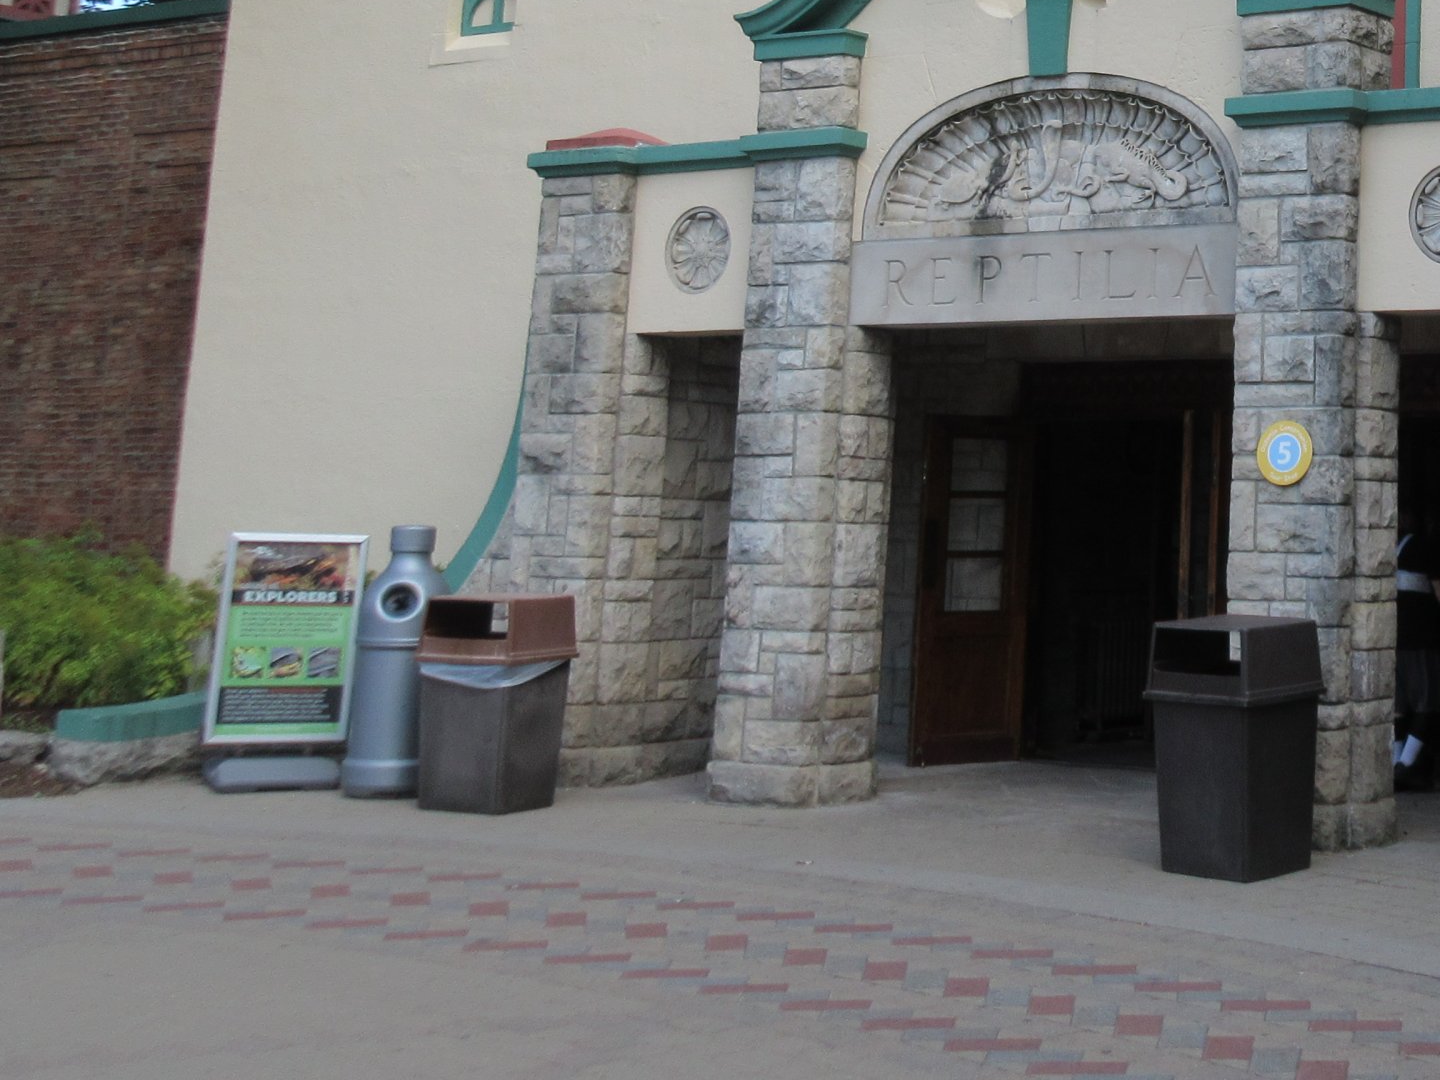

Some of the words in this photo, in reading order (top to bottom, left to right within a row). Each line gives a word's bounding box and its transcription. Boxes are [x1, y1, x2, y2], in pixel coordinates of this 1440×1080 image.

[882, 243, 1219, 308] REPTILIA
[1277, 441, 1291, 465] 5
[242, 590, 338, 604] EXPLORERS
